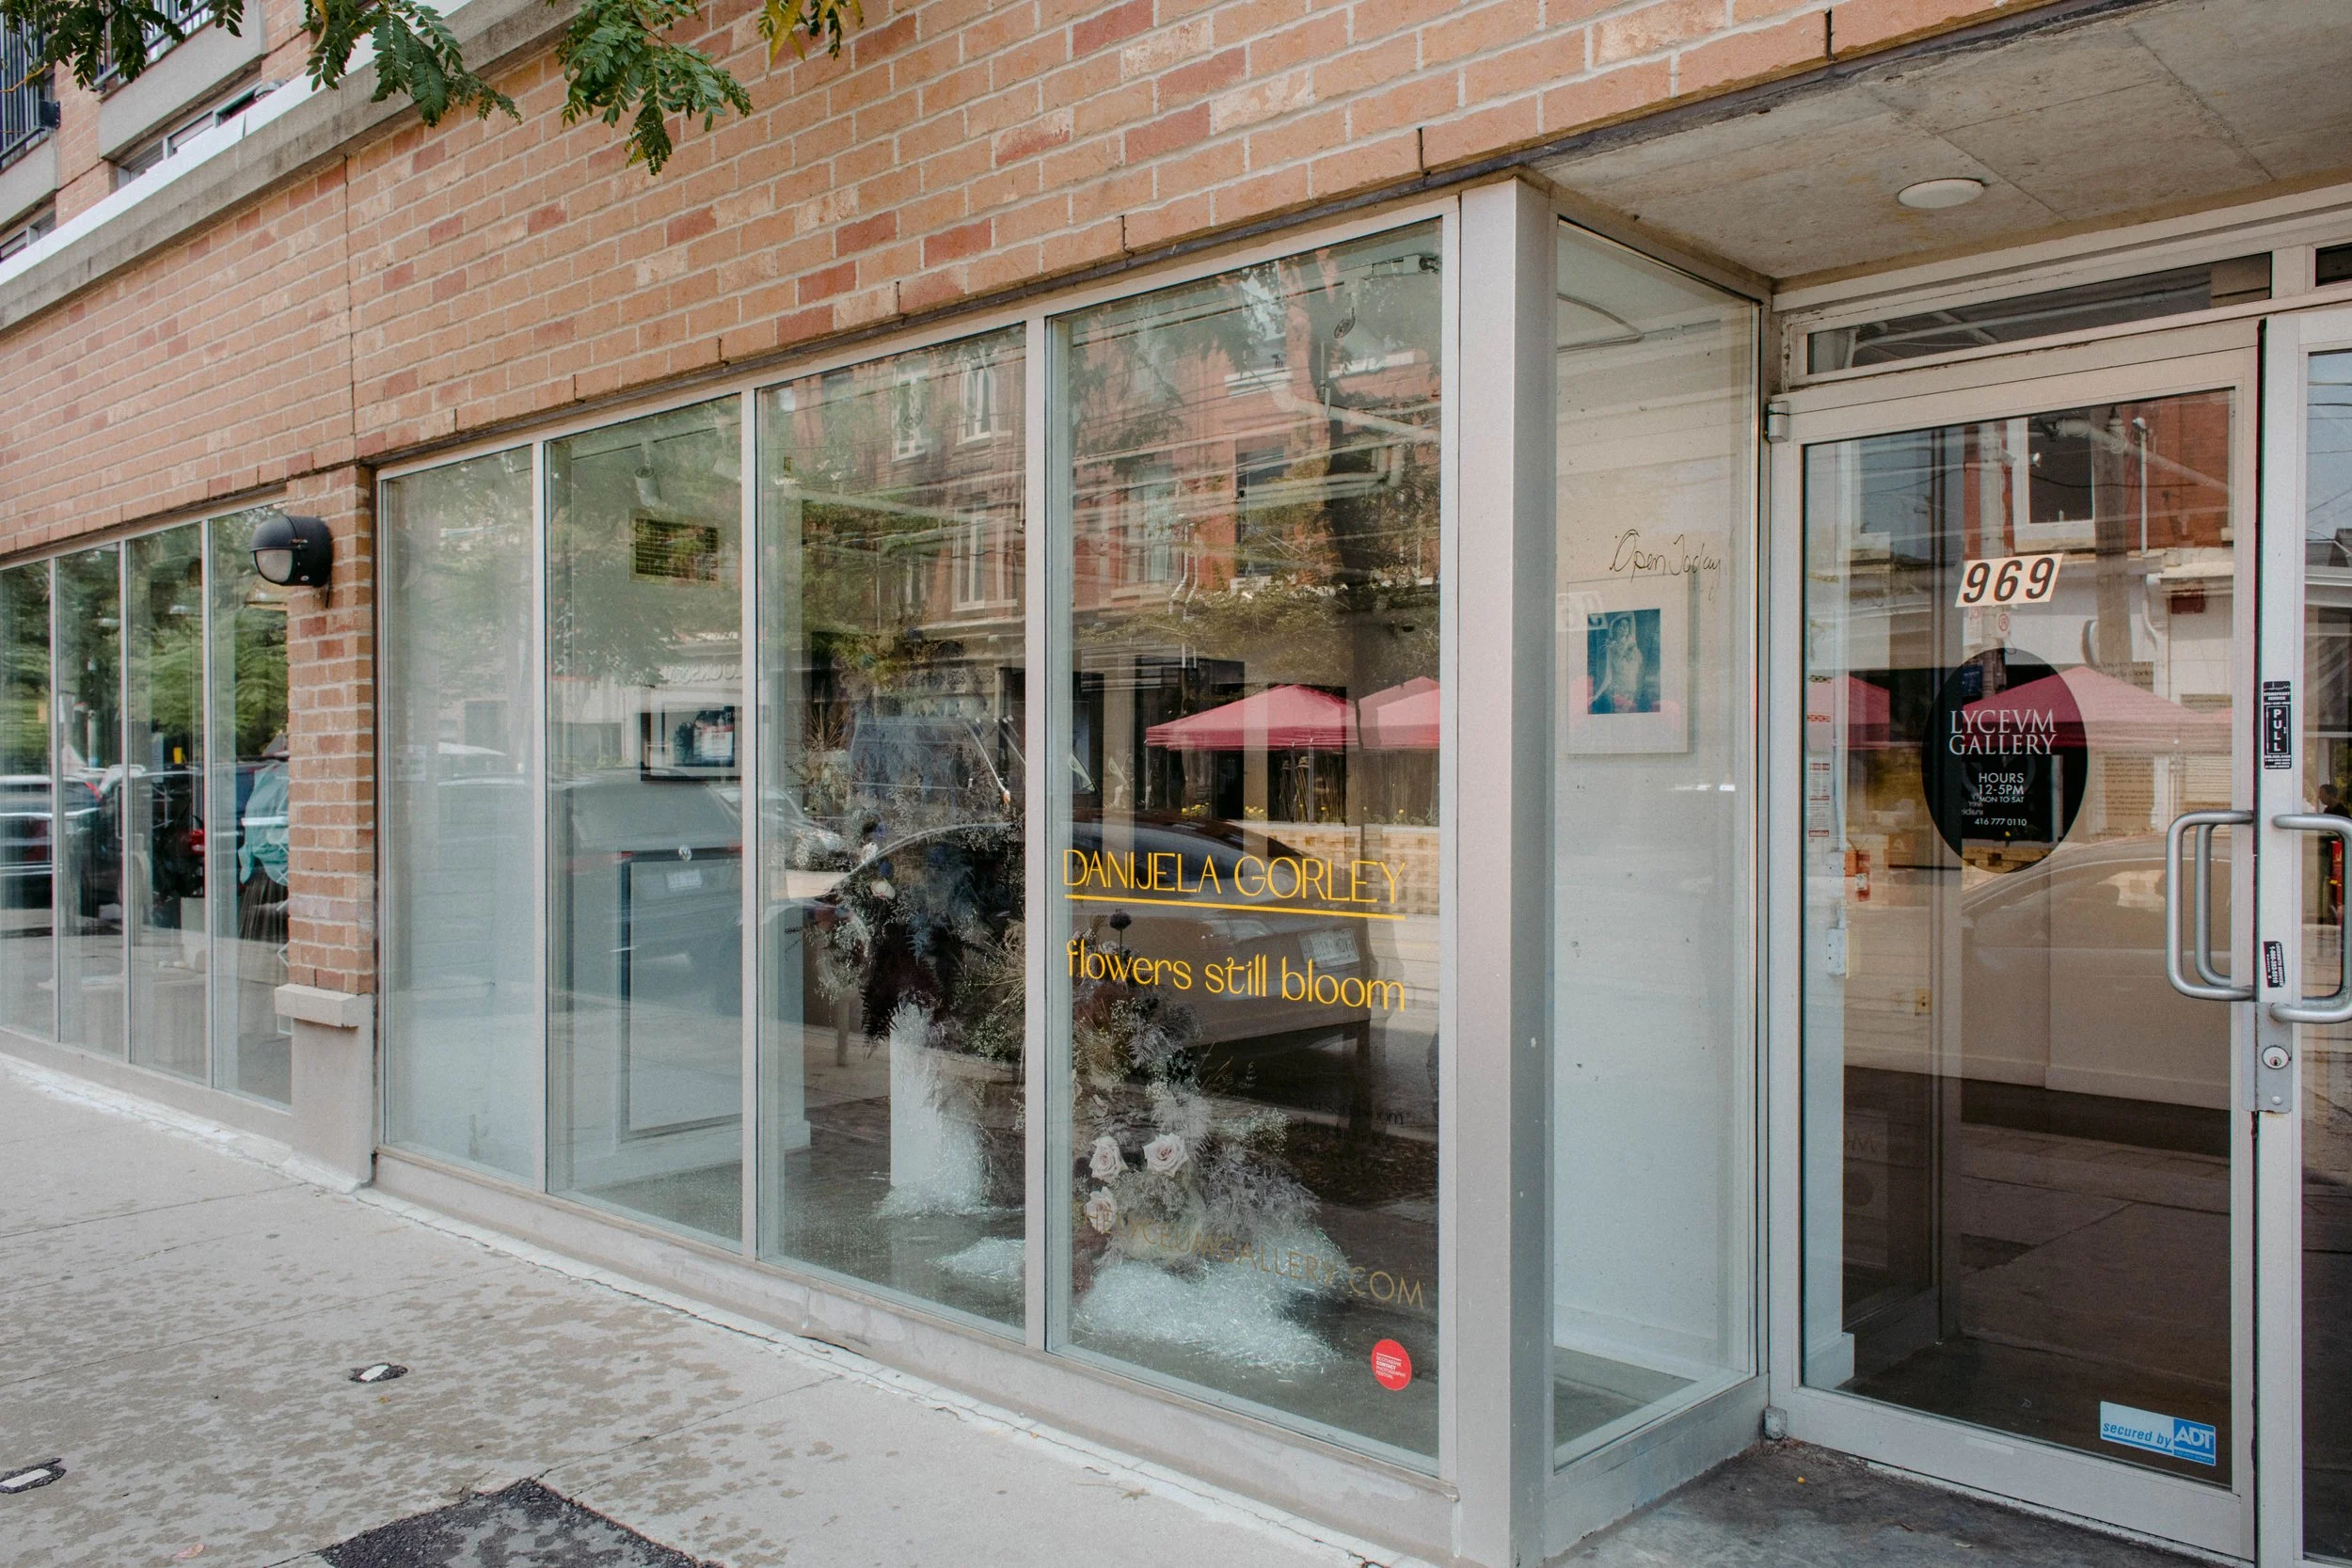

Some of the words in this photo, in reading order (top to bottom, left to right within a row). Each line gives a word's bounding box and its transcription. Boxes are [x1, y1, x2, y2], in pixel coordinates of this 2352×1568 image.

[1609, 529, 1666, 583] Open
[1963, 557, 2055, 603] 969
[1949, 708, 2057, 735] LYCEVM
[2273, 708, 2282, 752] PULL
[1948, 734, 2058, 755] GALLERY
[1979, 772, 2025, 784] HOURS
[1979, 784, 2025, 795] 12-5PM
[1991, 817, 2006, 826] 777
[1063, 849, 1221, 895] DANIJELA
[1234, 855, 1406, 904] GORLEY
[1066, 939, 1192, 990] flowers
[1205, 953, 1268, 998] still
[1281, 956, 1406, 1012] bloom
[2103, 1422, 2153, 1442] secured
[2156, 1432, 2172, 1449] by
[2174, 1425, 2215, 1449] ADT
